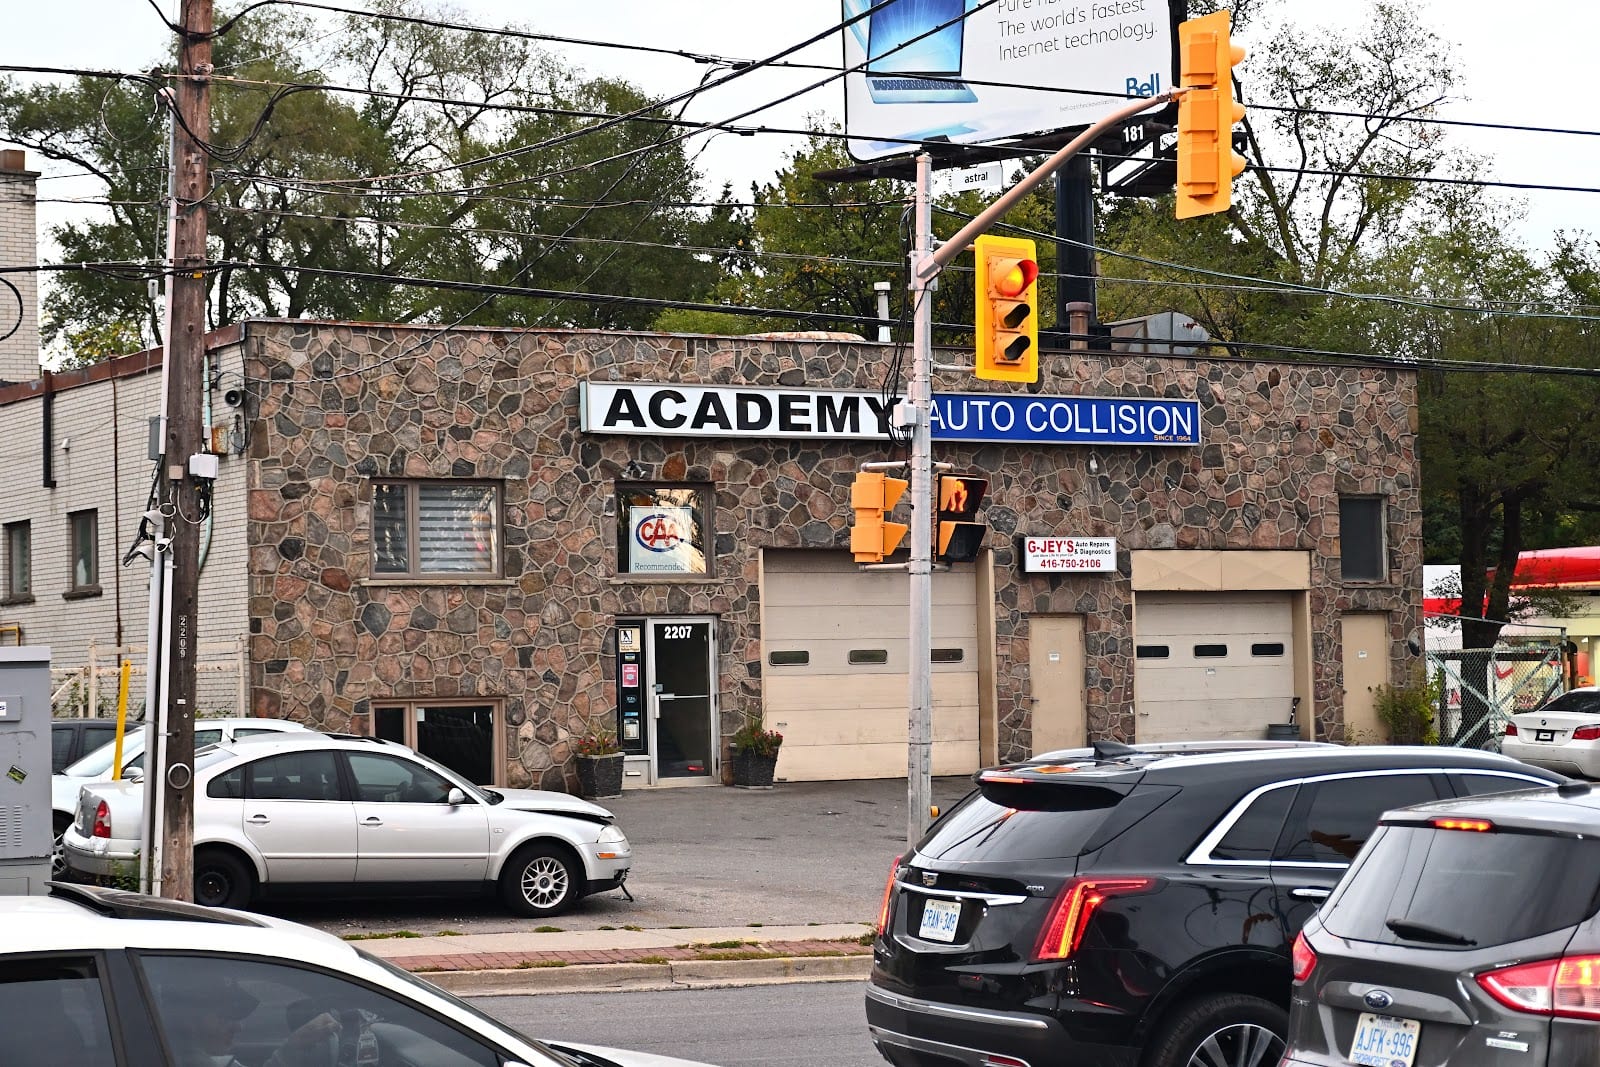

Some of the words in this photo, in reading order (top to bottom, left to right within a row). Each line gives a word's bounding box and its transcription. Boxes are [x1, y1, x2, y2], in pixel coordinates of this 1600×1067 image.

[998, 20, 1026, 37] The
[1031, 6, 1087, 32] world's
[1092, 0, 1146, 20] fastest
[999, 37, 1060, 61] Internet
[1065, 21, 1158, 49] technology.
[1126, 73, 1160, 100] Bell
[1122, 124, 1144, 142] 181
[964, 171, 989, 183] astral
[602, 388, 903, 433] ACADEMY
[930, 399, 1015, 432] AUTO
[1025, 401, 1192, 435] COLLISION
[1027, 540, 1075, 553] G-JEY'S
[1079, 548, 1111, 556] Diagnostics
[1040, 559, 1101, 568] 416-750-2106
[179, 616, 187, 658] 2209
[664, 625, 693, 639] 2207
